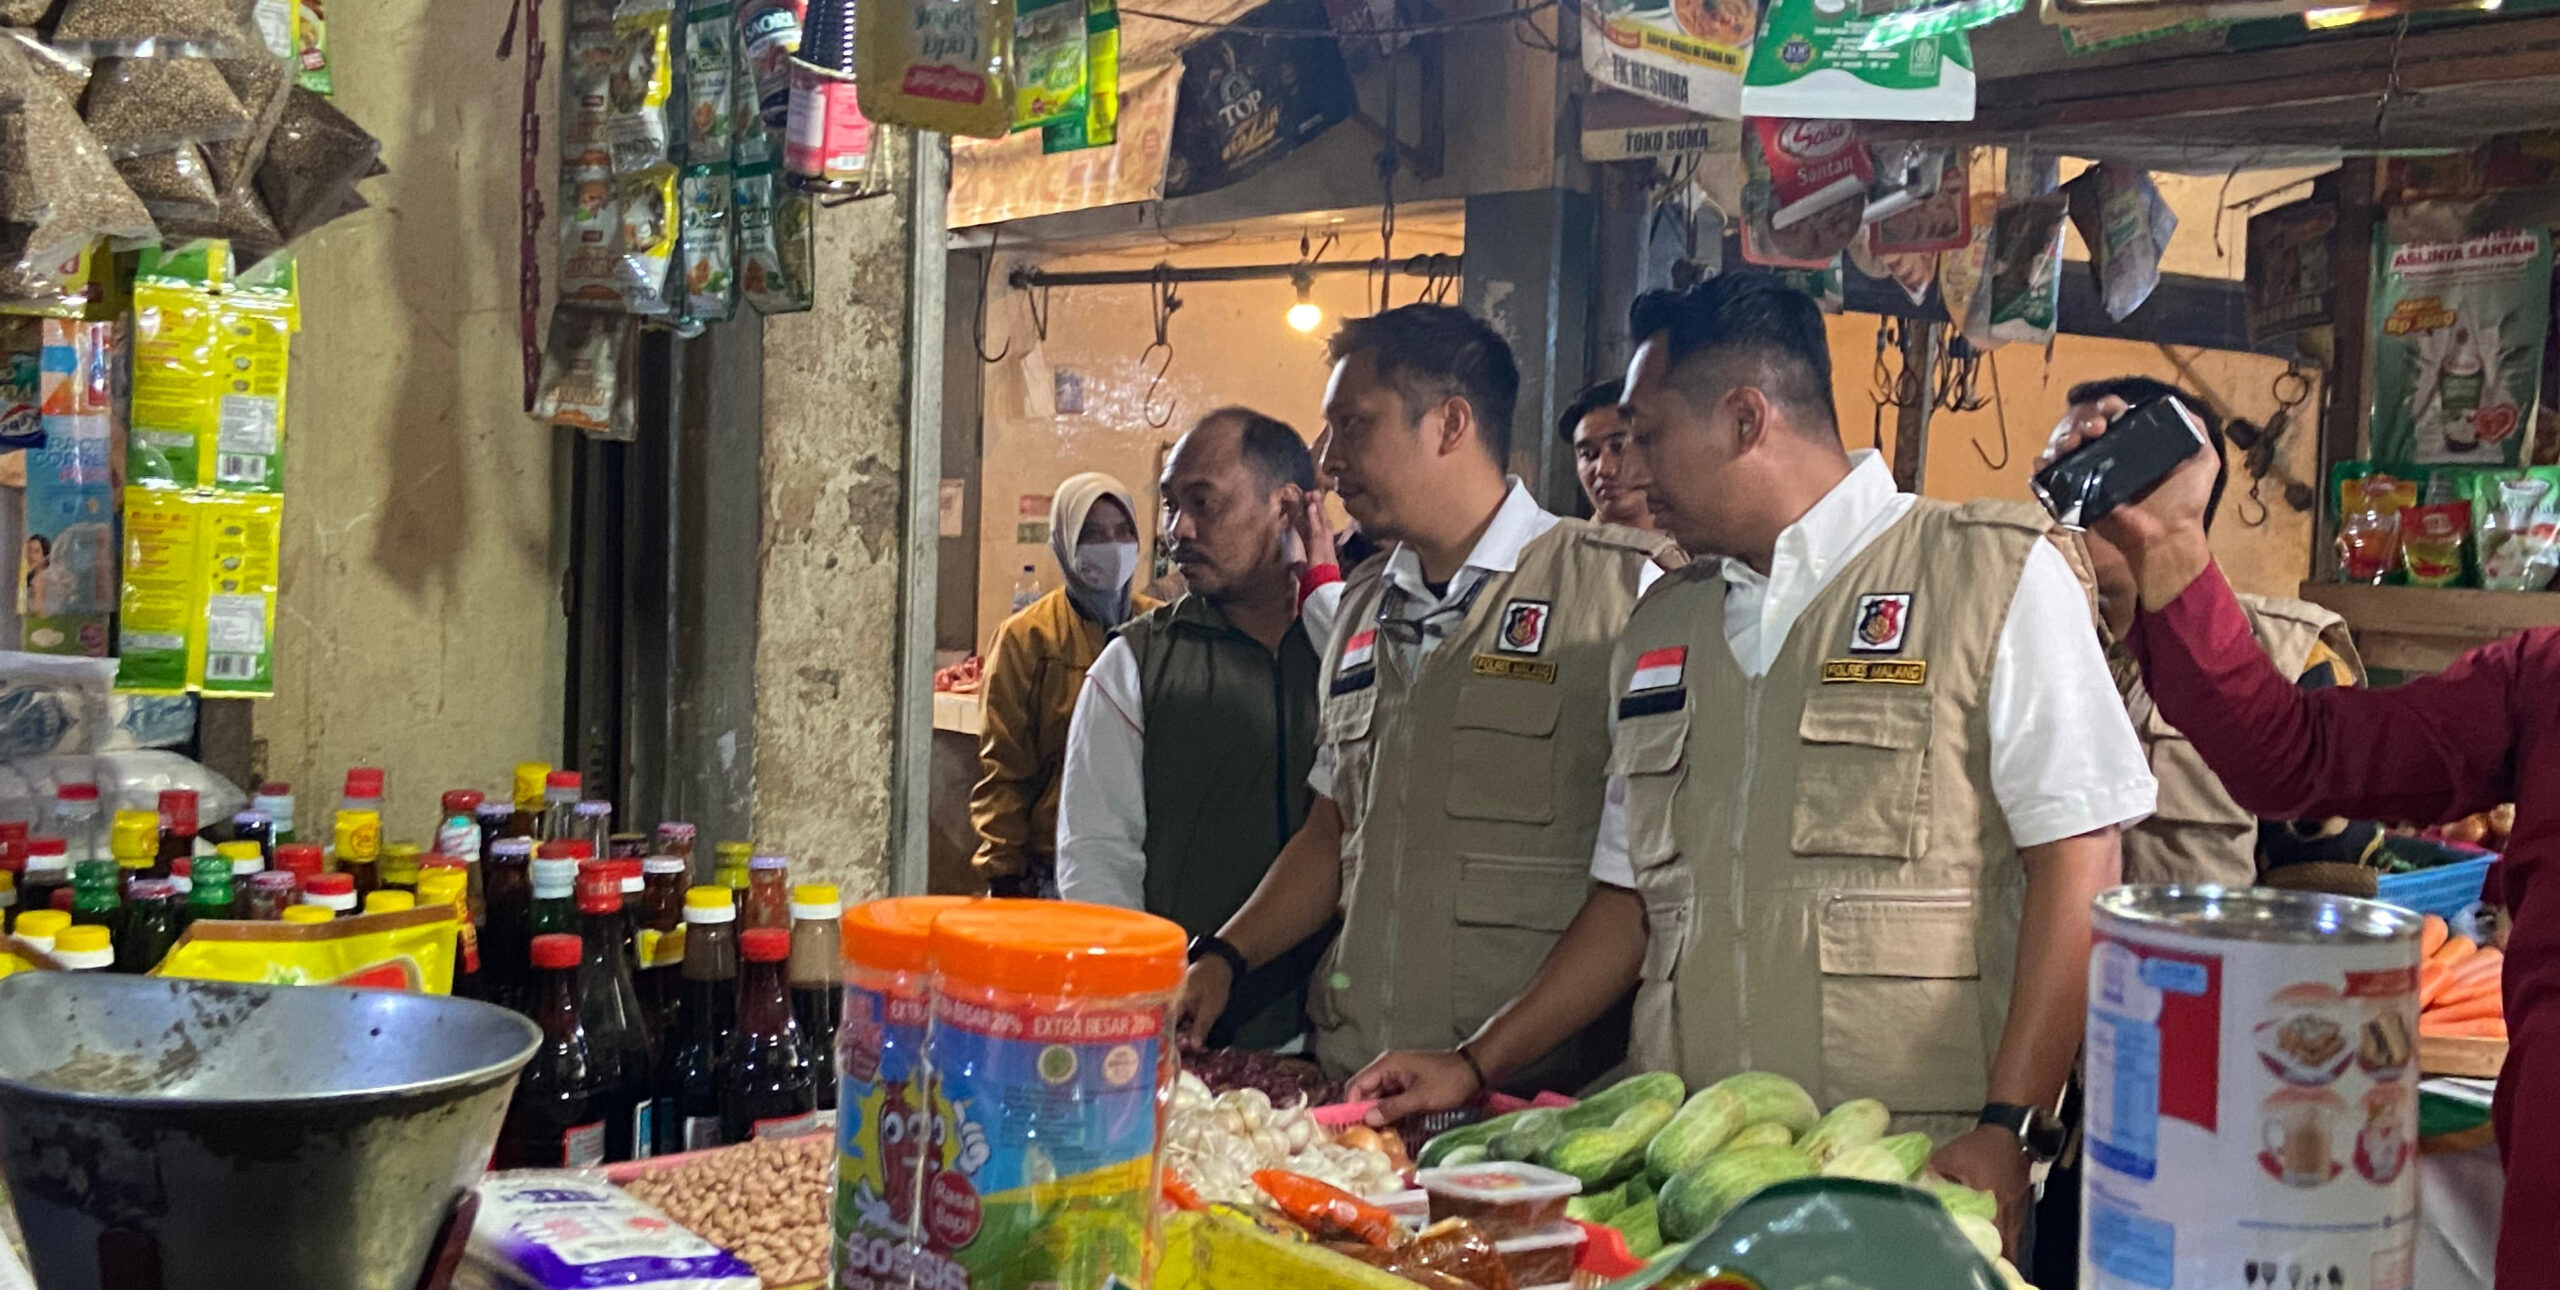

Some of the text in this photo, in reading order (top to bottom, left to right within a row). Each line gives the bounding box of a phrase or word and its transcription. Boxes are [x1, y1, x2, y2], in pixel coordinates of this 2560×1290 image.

[1218, 89, 1262, 127] TOP
[1626, 128, 1709, 152] TOKO SUMA
[1793, 119, 1844, 149] Sasa
[1797, 155, 1854, 186] Santan
[2468, 240, 2536, 260] SANTAN
[1826, 663, 1921, 680] POLRES MALANG
[1034, 1017, 1082, 1036] EXTRA
[1085, 1016, 1128, 1035] BESAR
[934, 1180, 976, 1211] Rasa
[936, 1205, 971, 1235] Sapi
